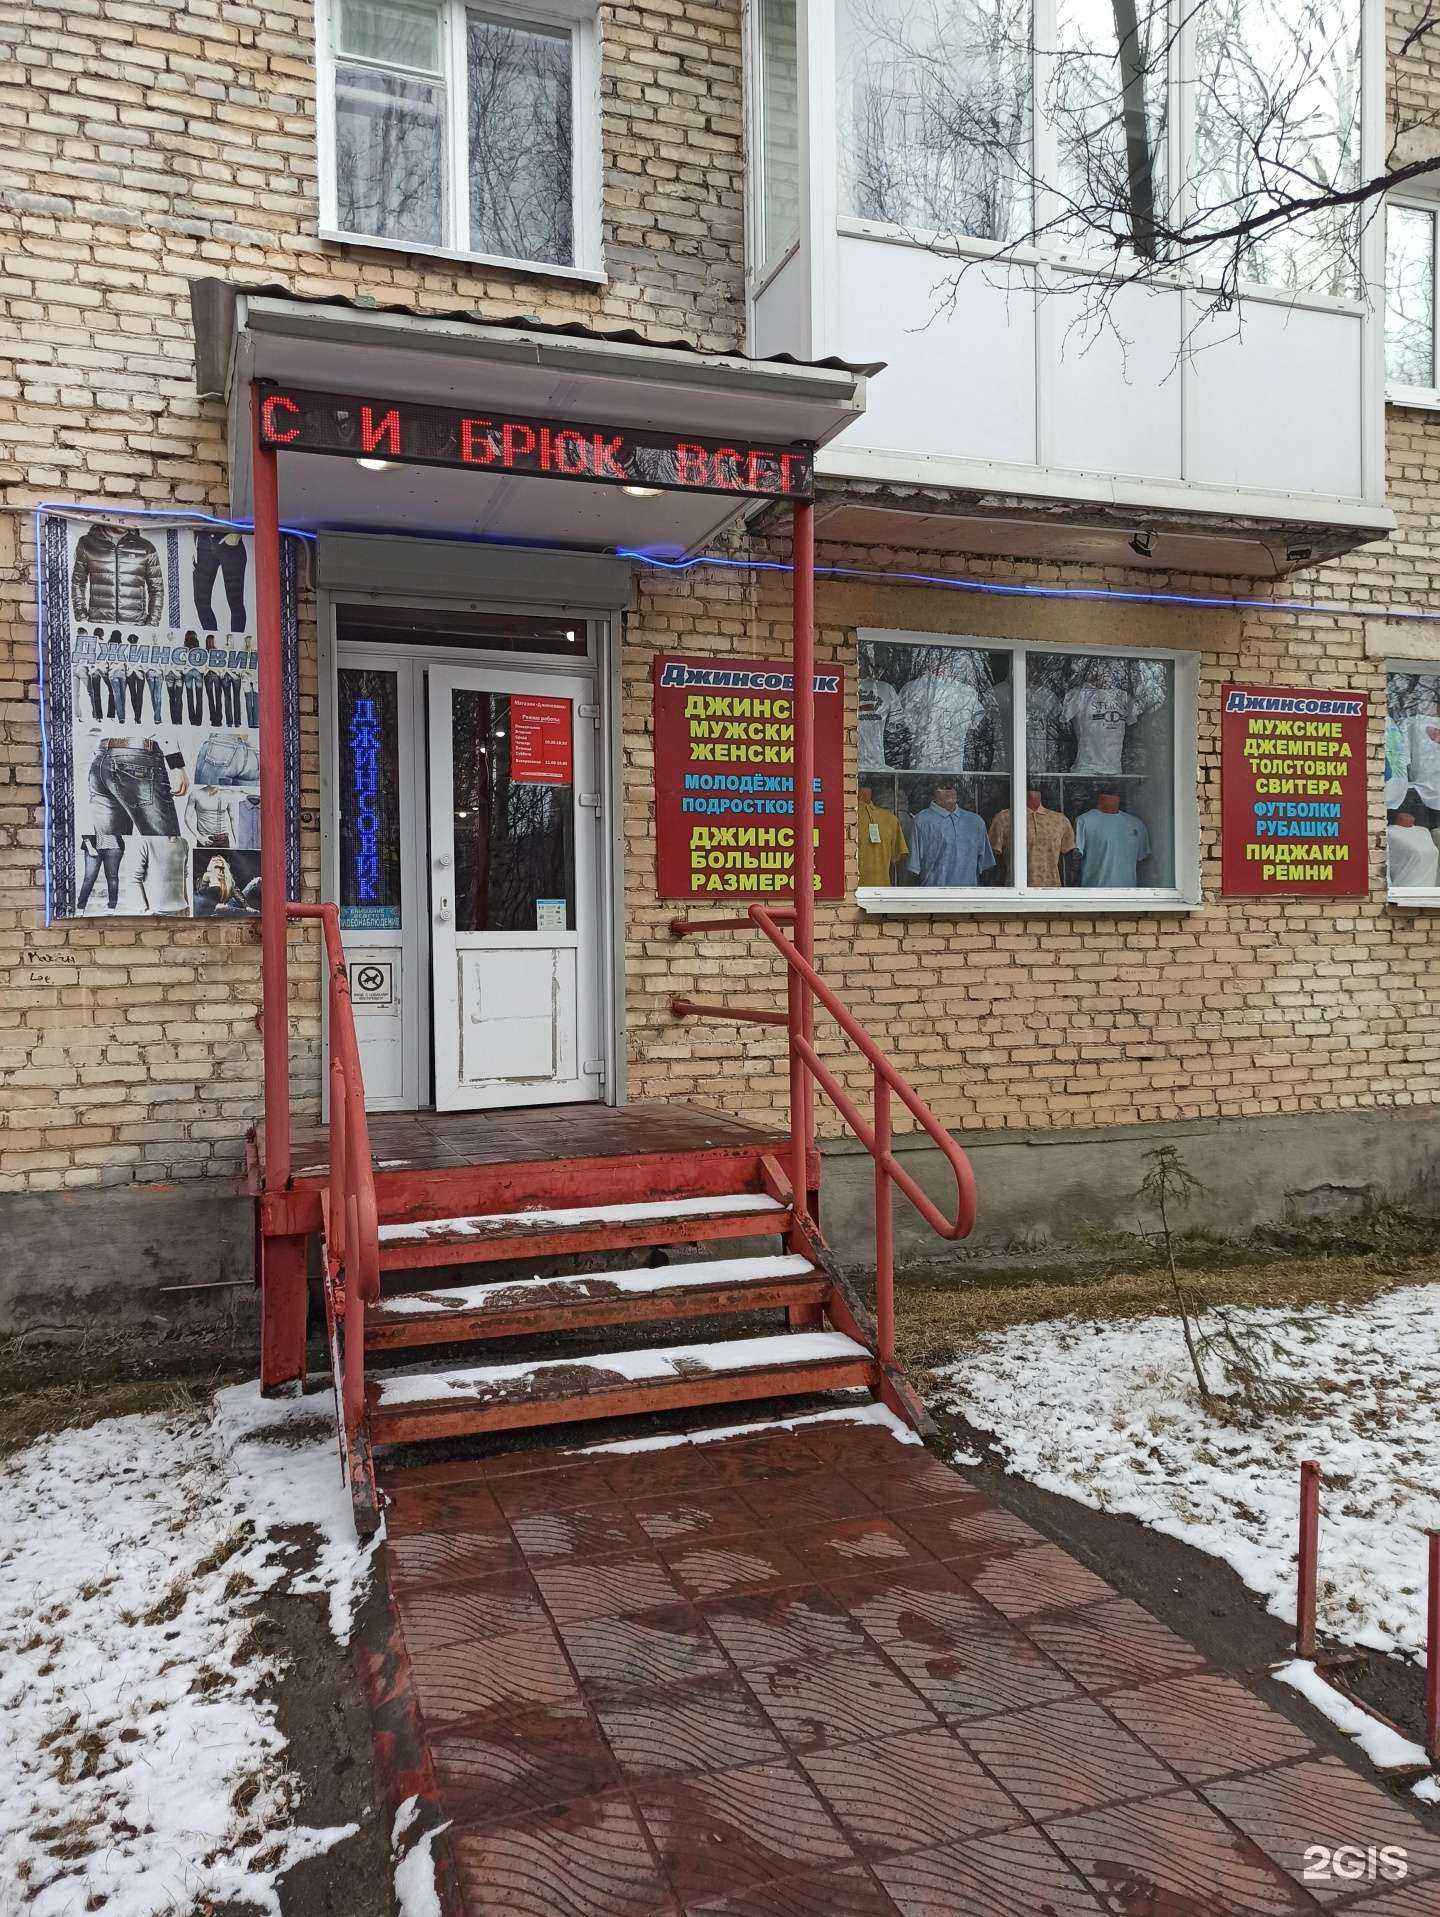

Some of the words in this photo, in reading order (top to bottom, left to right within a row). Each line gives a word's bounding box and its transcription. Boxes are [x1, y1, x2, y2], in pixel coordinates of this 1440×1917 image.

[263, 395, 299, 443] С
[361, 407, 400, 454] И
[460, 418, 628, 480] БРЮК
[685, 695, 814, 719] ДЖИНС
[690, 720, 794, 741] МУЖСКИ
[1248, 719, 1343, 738] МУЖСКИЕ
[690, 743, 794, 763] ЖЕНСКИ
[1244, 738, 1352, 757] ДЖЕМПЕРА
[1249, 758, 1348, 776] ТОЛСТОВКИ
[684, 774, 822, 793] МОЛОДЁЖНЕ
[1255, 778, 1343, 795] СВИТЕРА
[1254, 802, 1341, 817] ФУТБОЛКИ
[1256, 820, 1339, 837] РУБАШКИ
[1246, 844, 1349, 863] ПИДЖАКИ
[1263, 864, 1333, 880] РЕМНИ
